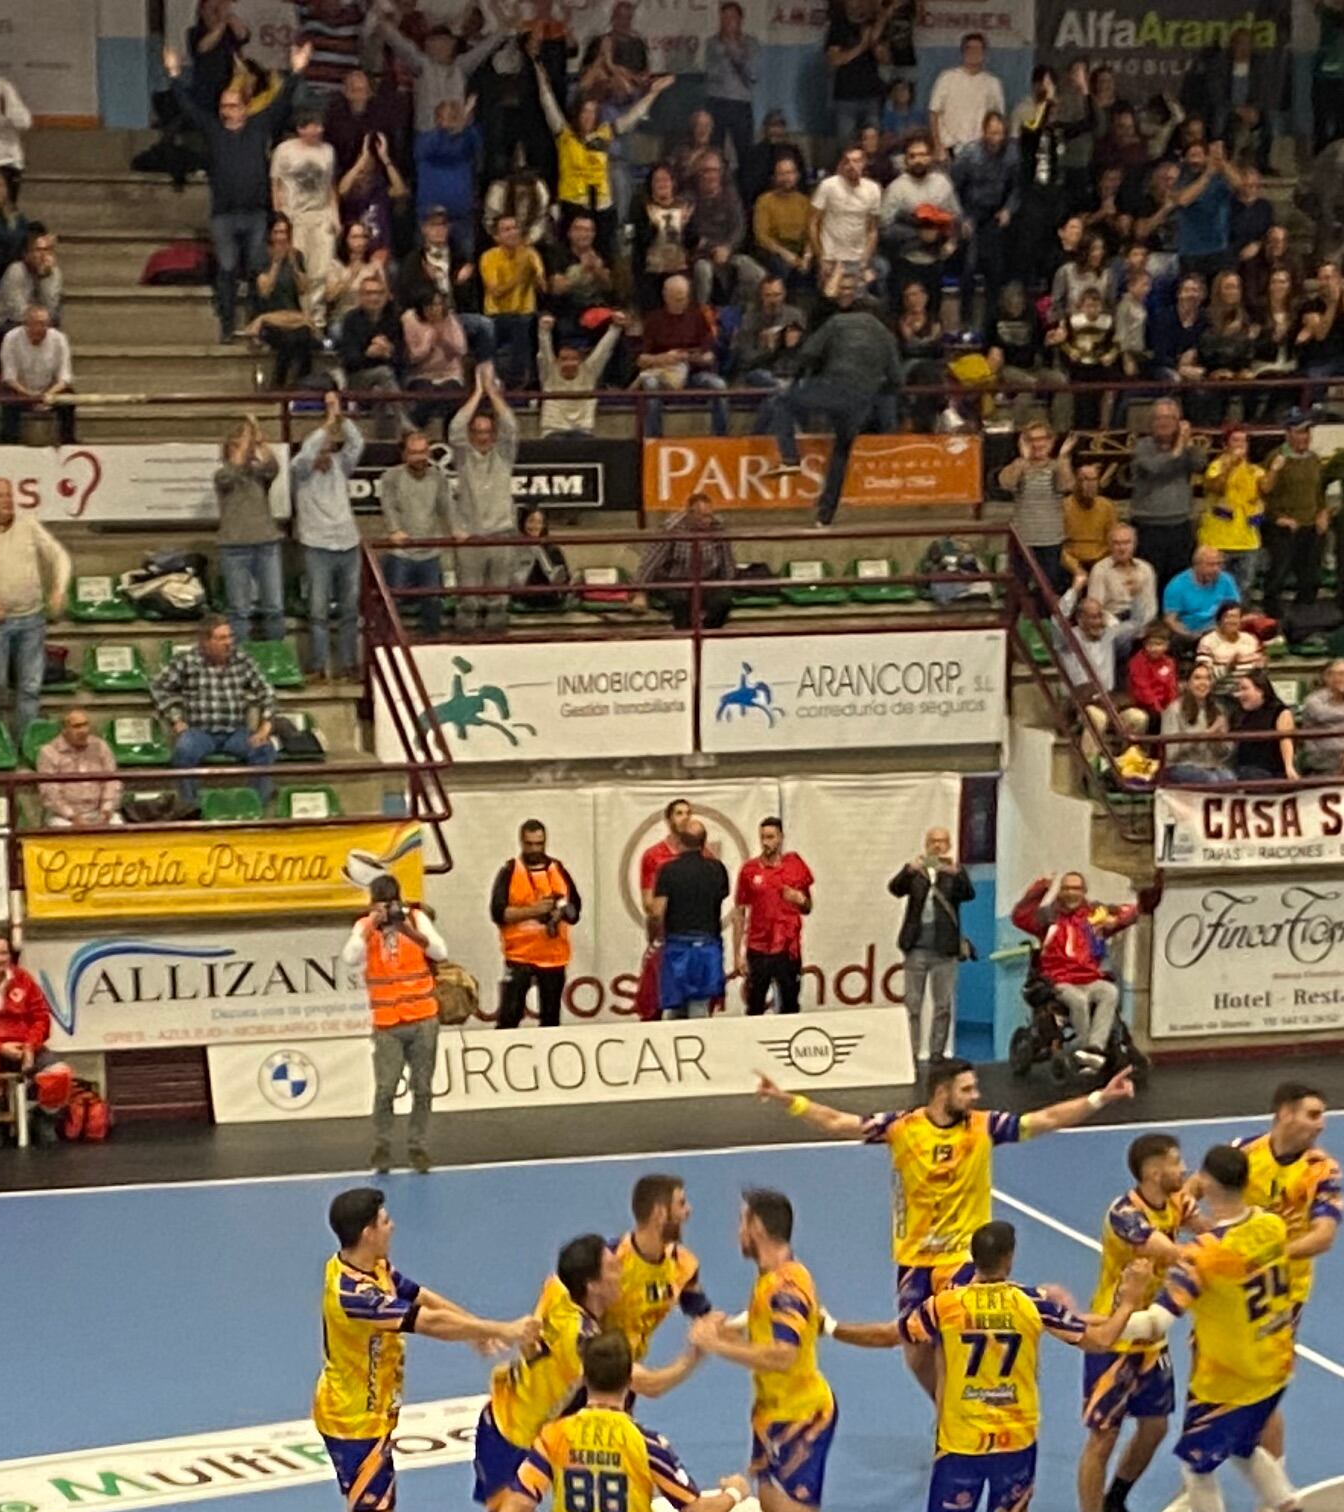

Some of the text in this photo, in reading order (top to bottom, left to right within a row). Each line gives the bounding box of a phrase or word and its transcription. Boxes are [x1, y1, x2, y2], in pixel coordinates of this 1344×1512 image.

[1054, 8, 1278, 50] AlfaAranda
[511, 475, 584, 496] EAM
[556, 668, 688, 696] INMOBICORP
[1204, 797, 1303, 840] CASA
[37, 843, 334, 901] Cafetería Prisma
[1212, 991, 1272, 1011] Hotel
[394, 1033, 711, 1100] URGOCAR
[794, 1045, 830, 1058] MINI
[960, 1333, 1023, 1378] 77
[569, 1449, 622, 1468] SERGIO
